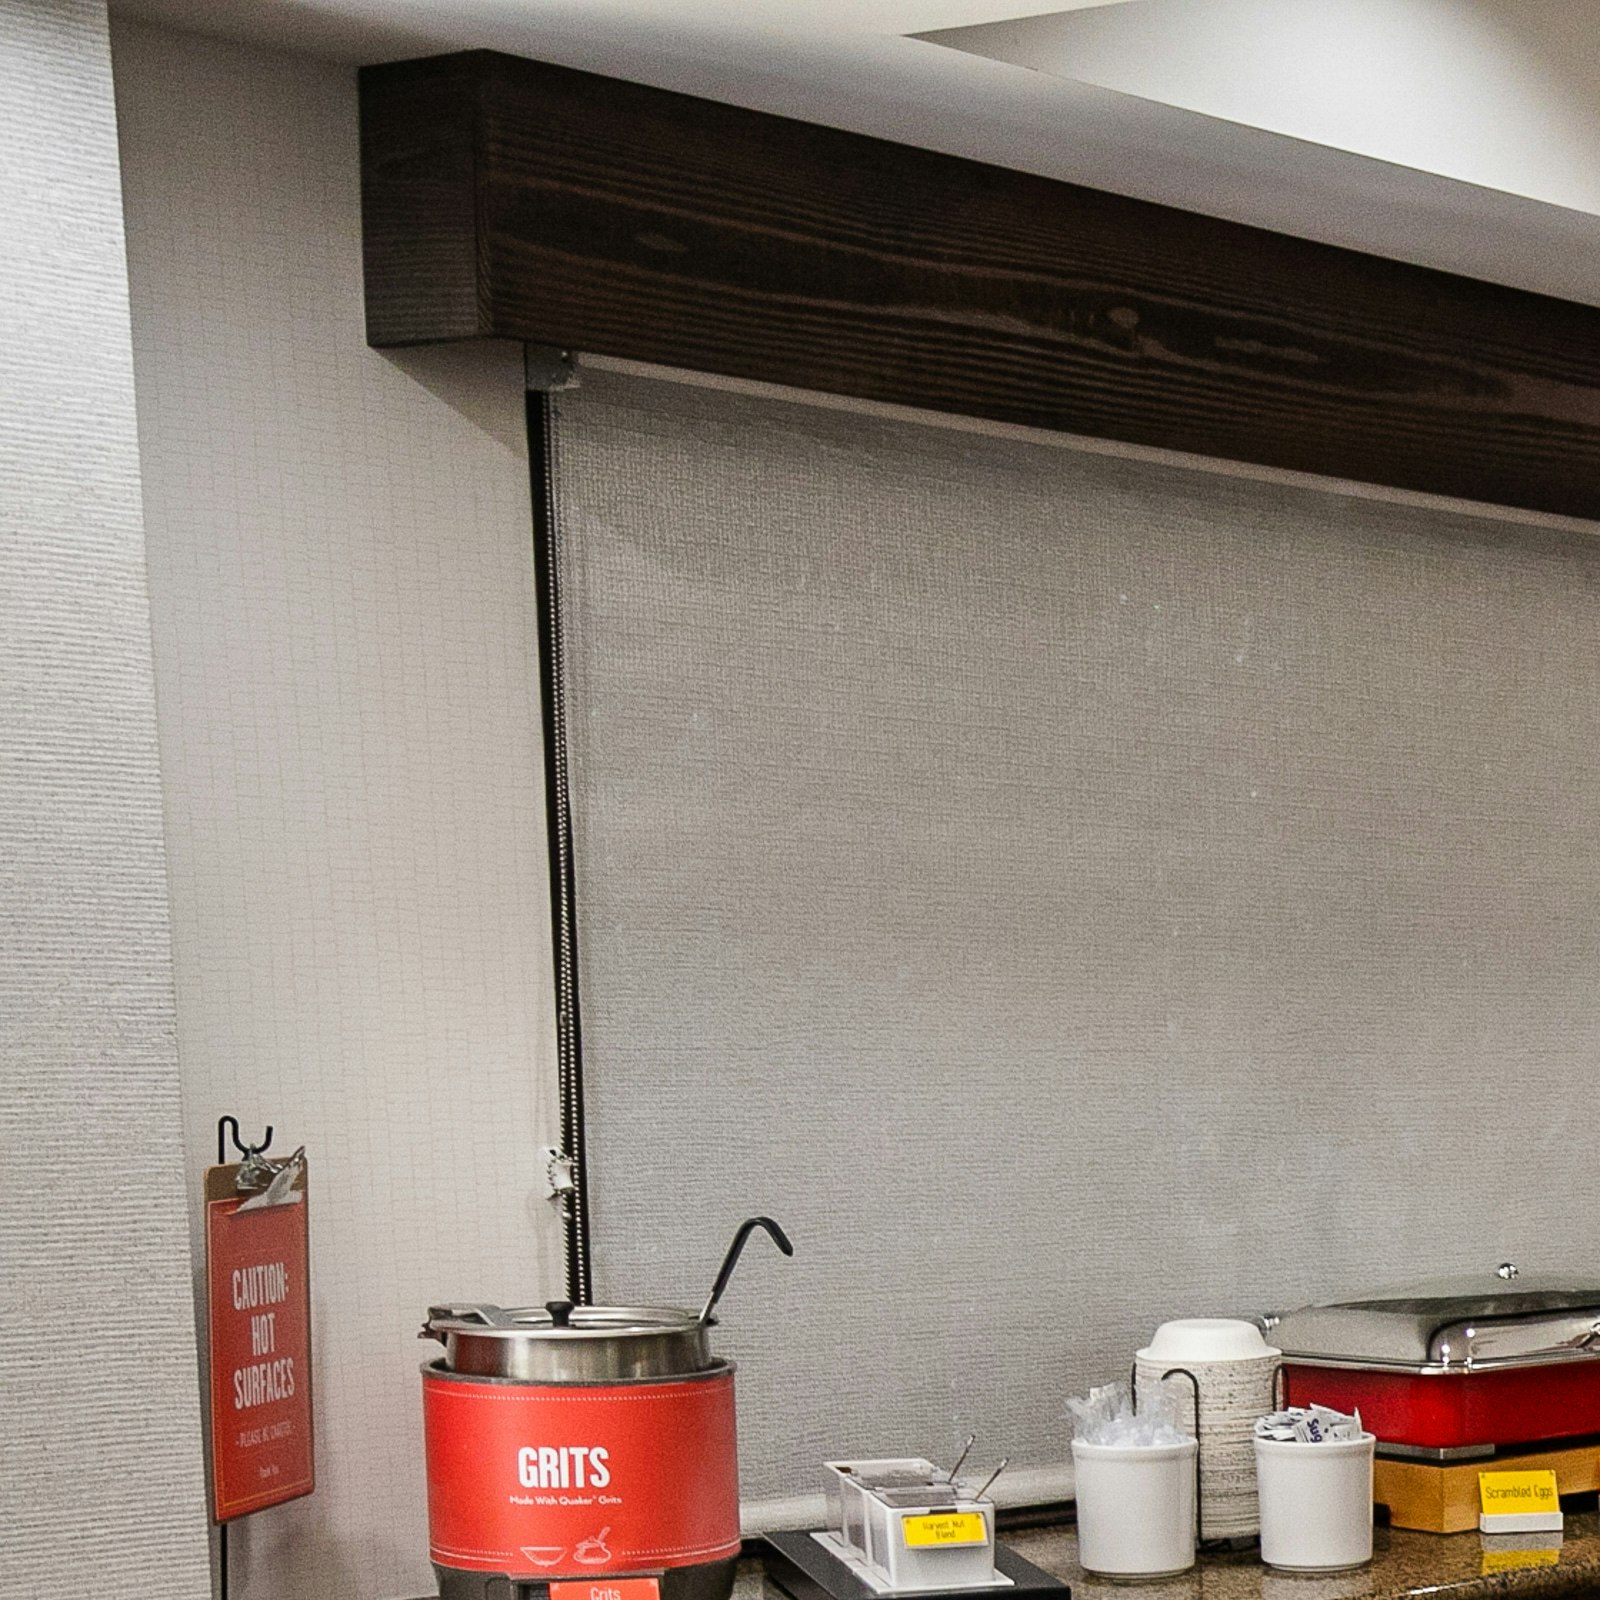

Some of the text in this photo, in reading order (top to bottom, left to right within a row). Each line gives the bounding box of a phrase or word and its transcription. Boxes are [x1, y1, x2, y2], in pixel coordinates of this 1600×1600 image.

[233, 1262, 289, 1311] CAUTION:
[251, 1312, 276, 1357] HOT
[233, 1357, 295, 1411] SURFACES
[517, 1446, 610, 1488] GRITS
[509, 1496, 534, 1505] Made
[535, 1496, 558, 1505] With
[598, 1496, 622, 1504] Grits
[1485, 1485, 1553, 1500] Scrambled Eggs
